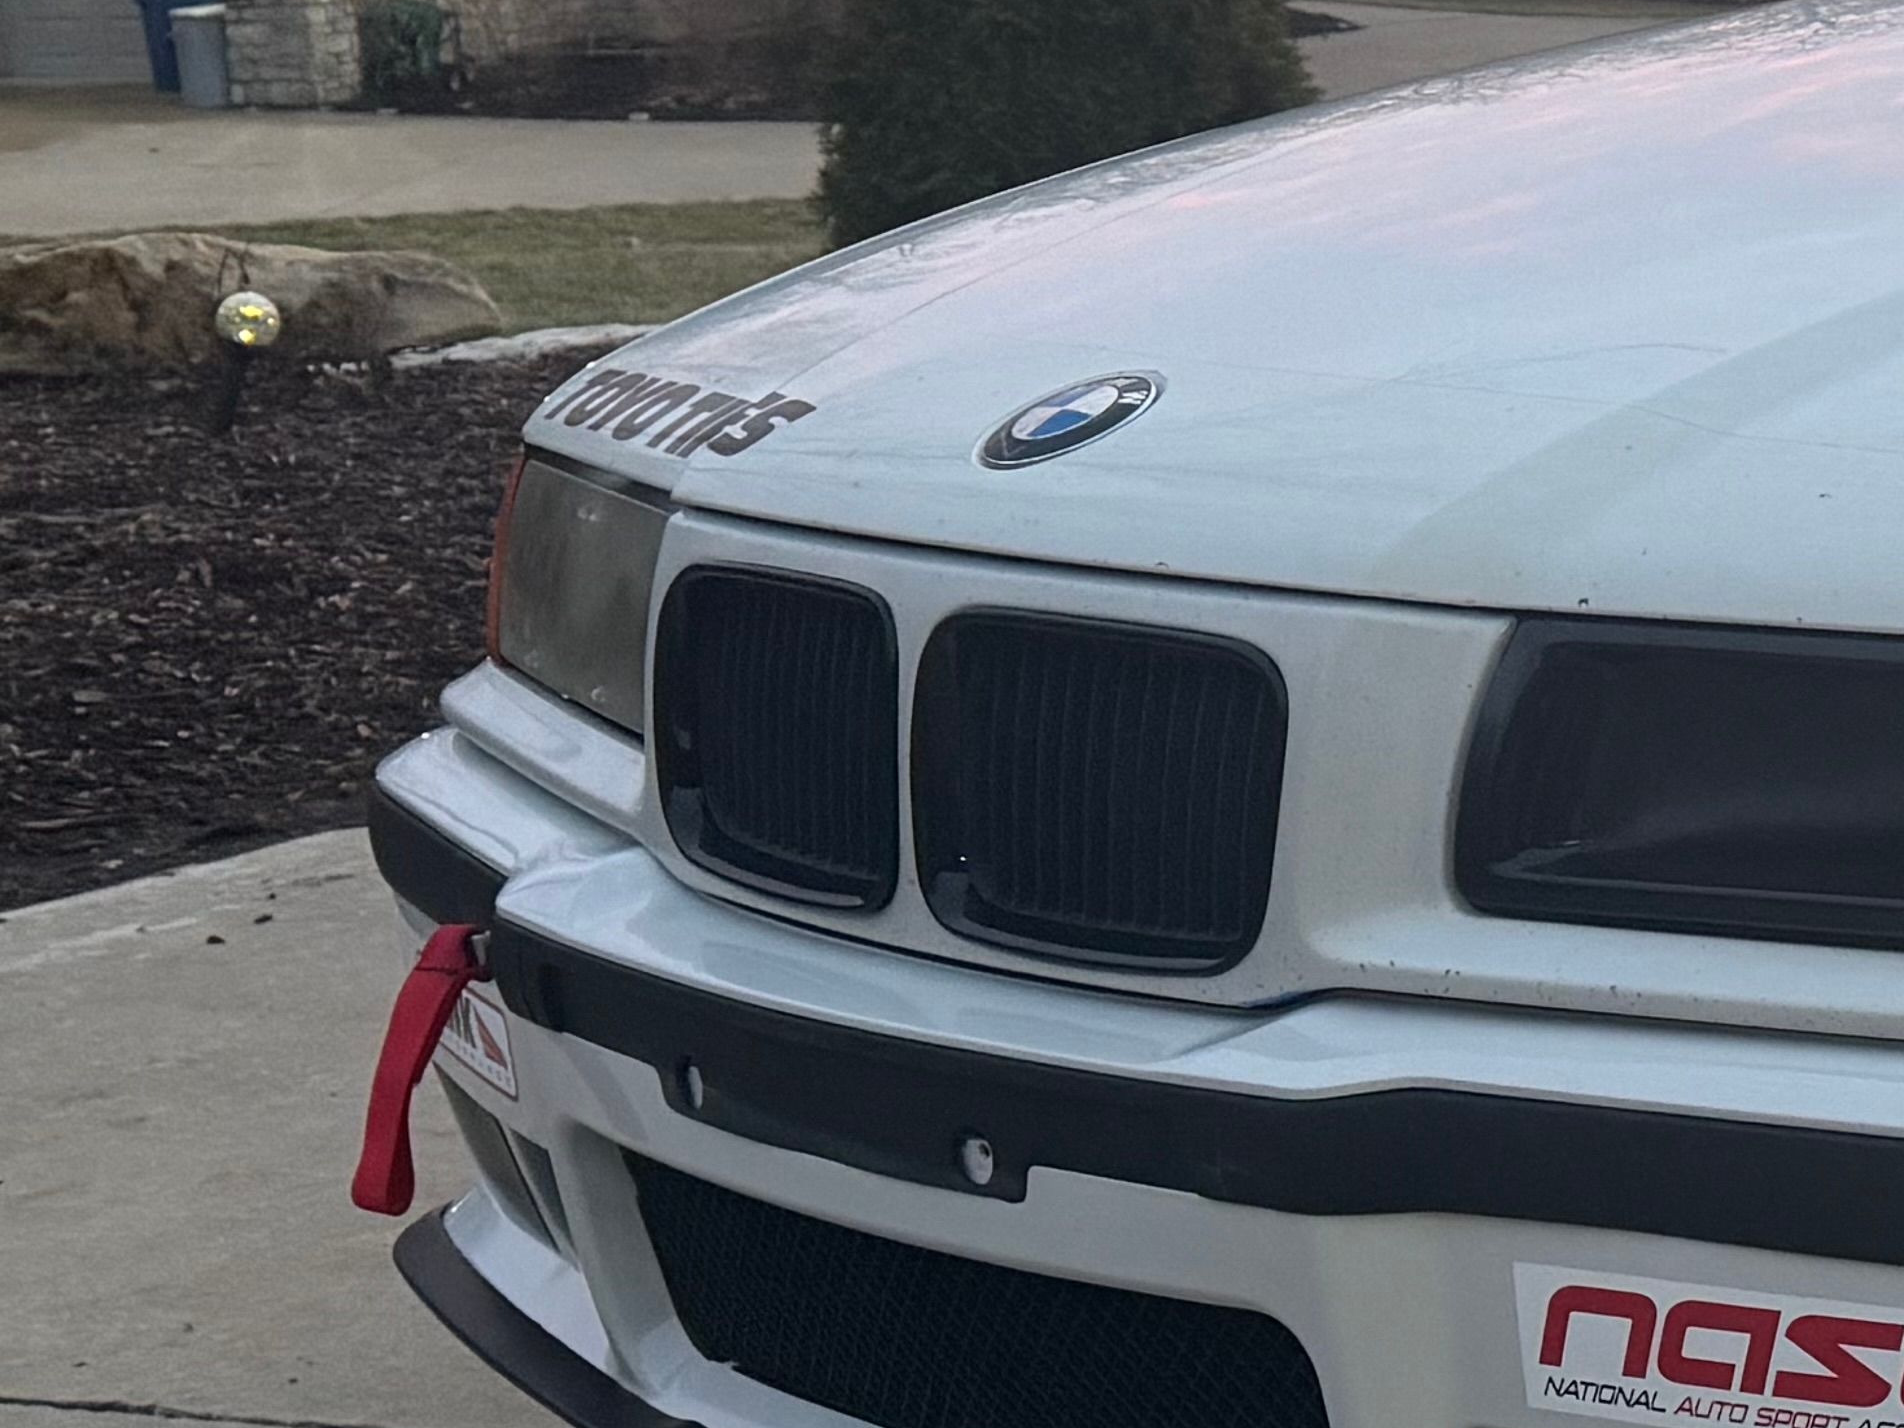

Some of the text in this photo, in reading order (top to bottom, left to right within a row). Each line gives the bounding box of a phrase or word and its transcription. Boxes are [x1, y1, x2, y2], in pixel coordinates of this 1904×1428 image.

[543, 368, 702, 441] TOYO
[1544, 1375, 1667, 1414] NATIONAL
[1674, 1396, 1749, 1424] AUTO
